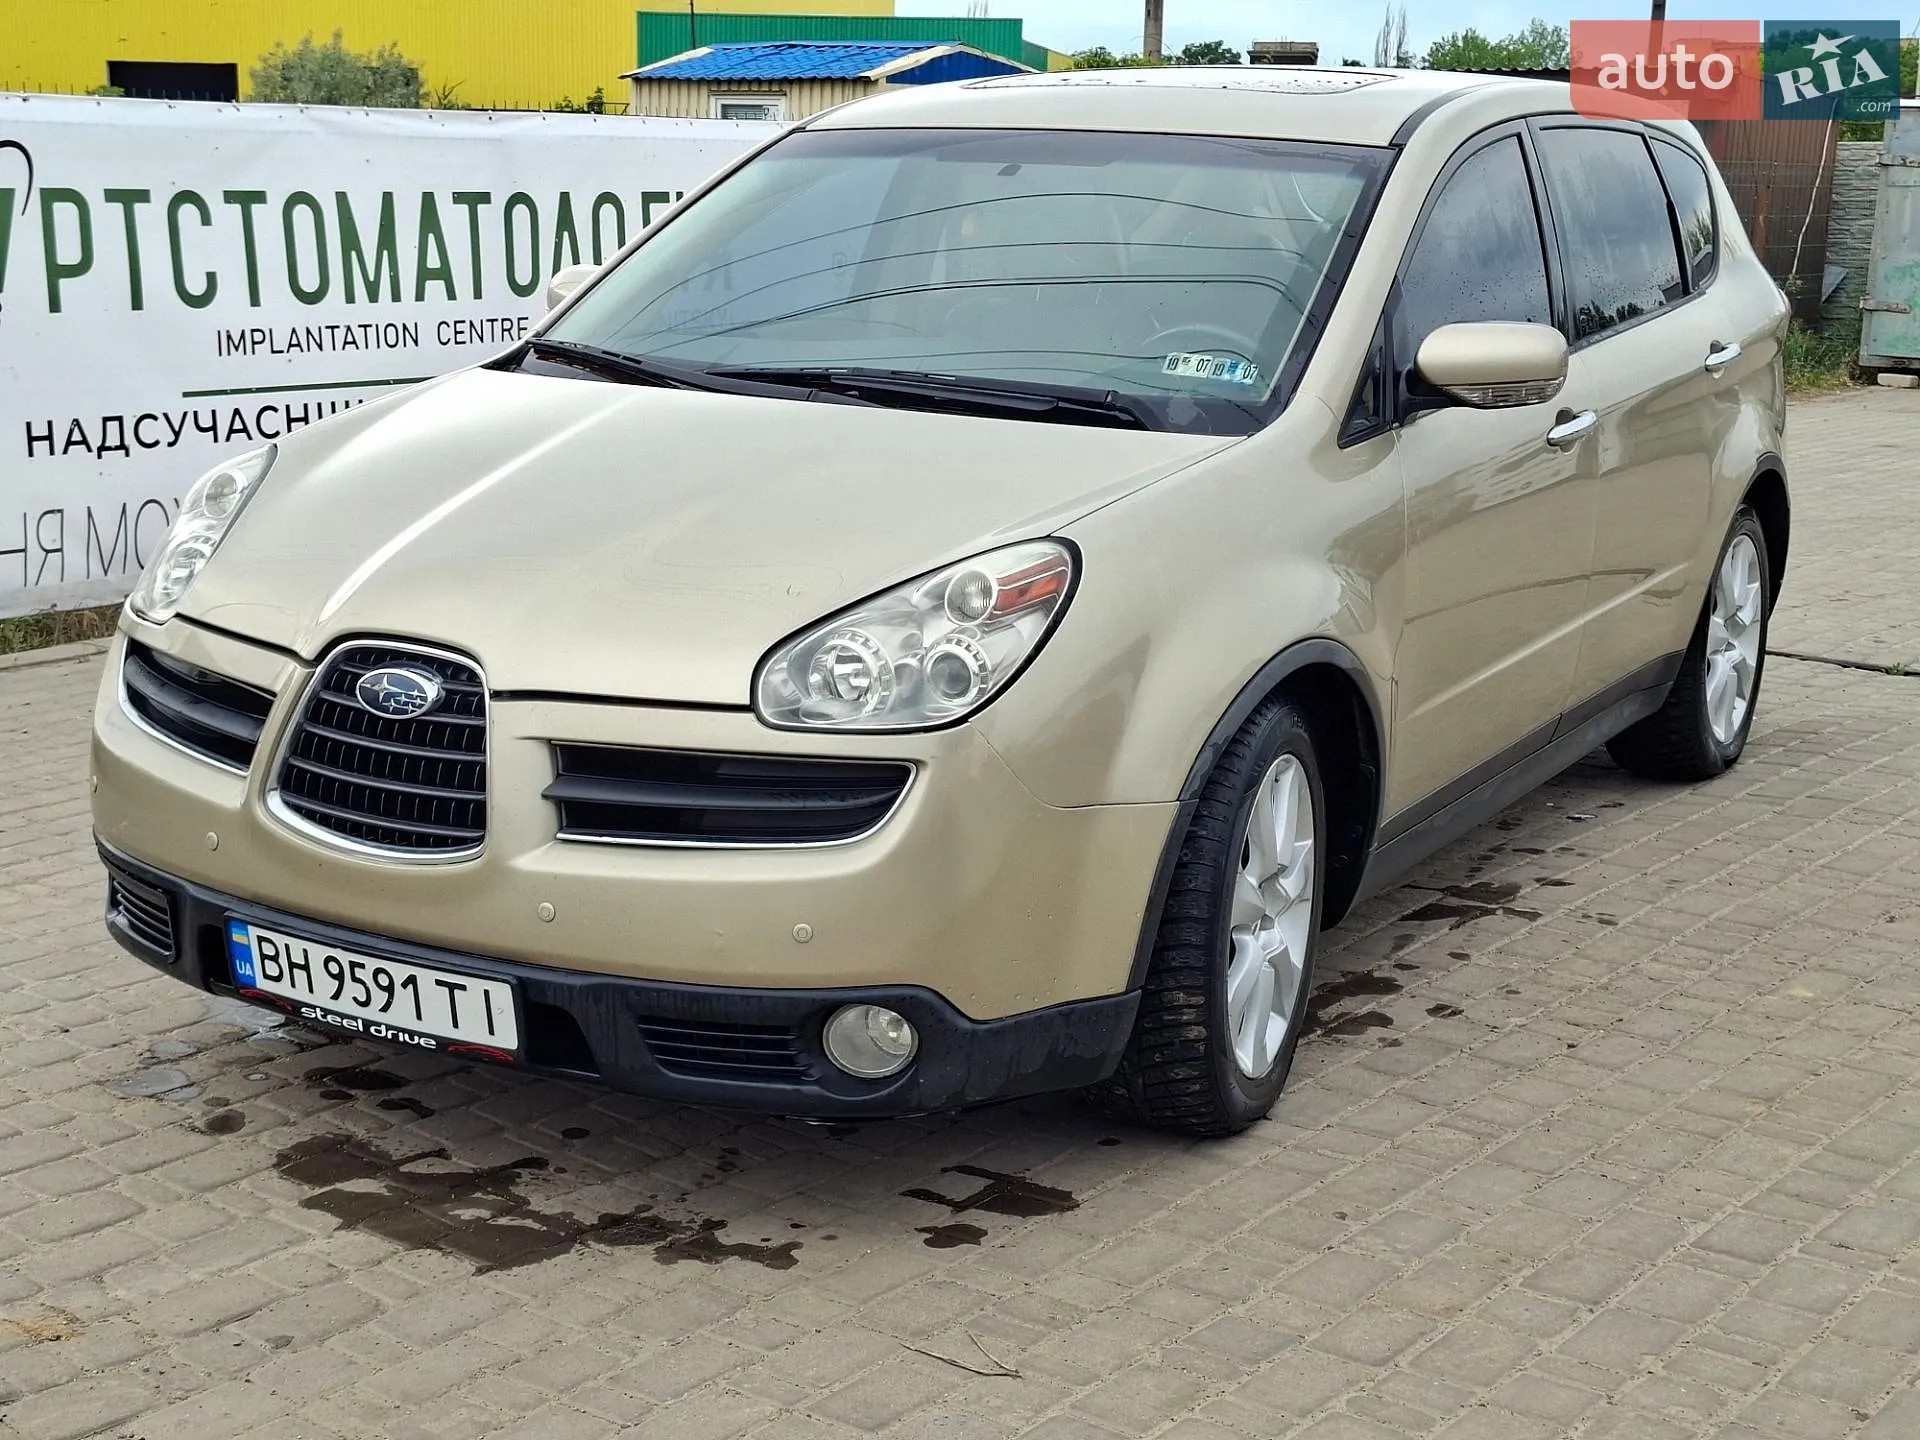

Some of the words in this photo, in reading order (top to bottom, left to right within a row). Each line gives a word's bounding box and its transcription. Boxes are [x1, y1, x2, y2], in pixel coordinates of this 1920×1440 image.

[216, 322, 420, 358] IMPLANTATION
[436, 316, 530, 346] CENTRE
[1195, 358, 1212, 374] 07
[235, 958, 254, 978] UA
[255, 933, 315, 995] BH
[322, 954, 424, 1022] 9591
[433, 977, 496, 1037] TI
[299, 1005, 365, 1034] steel
[368, 1023, 439, 1050] drive
